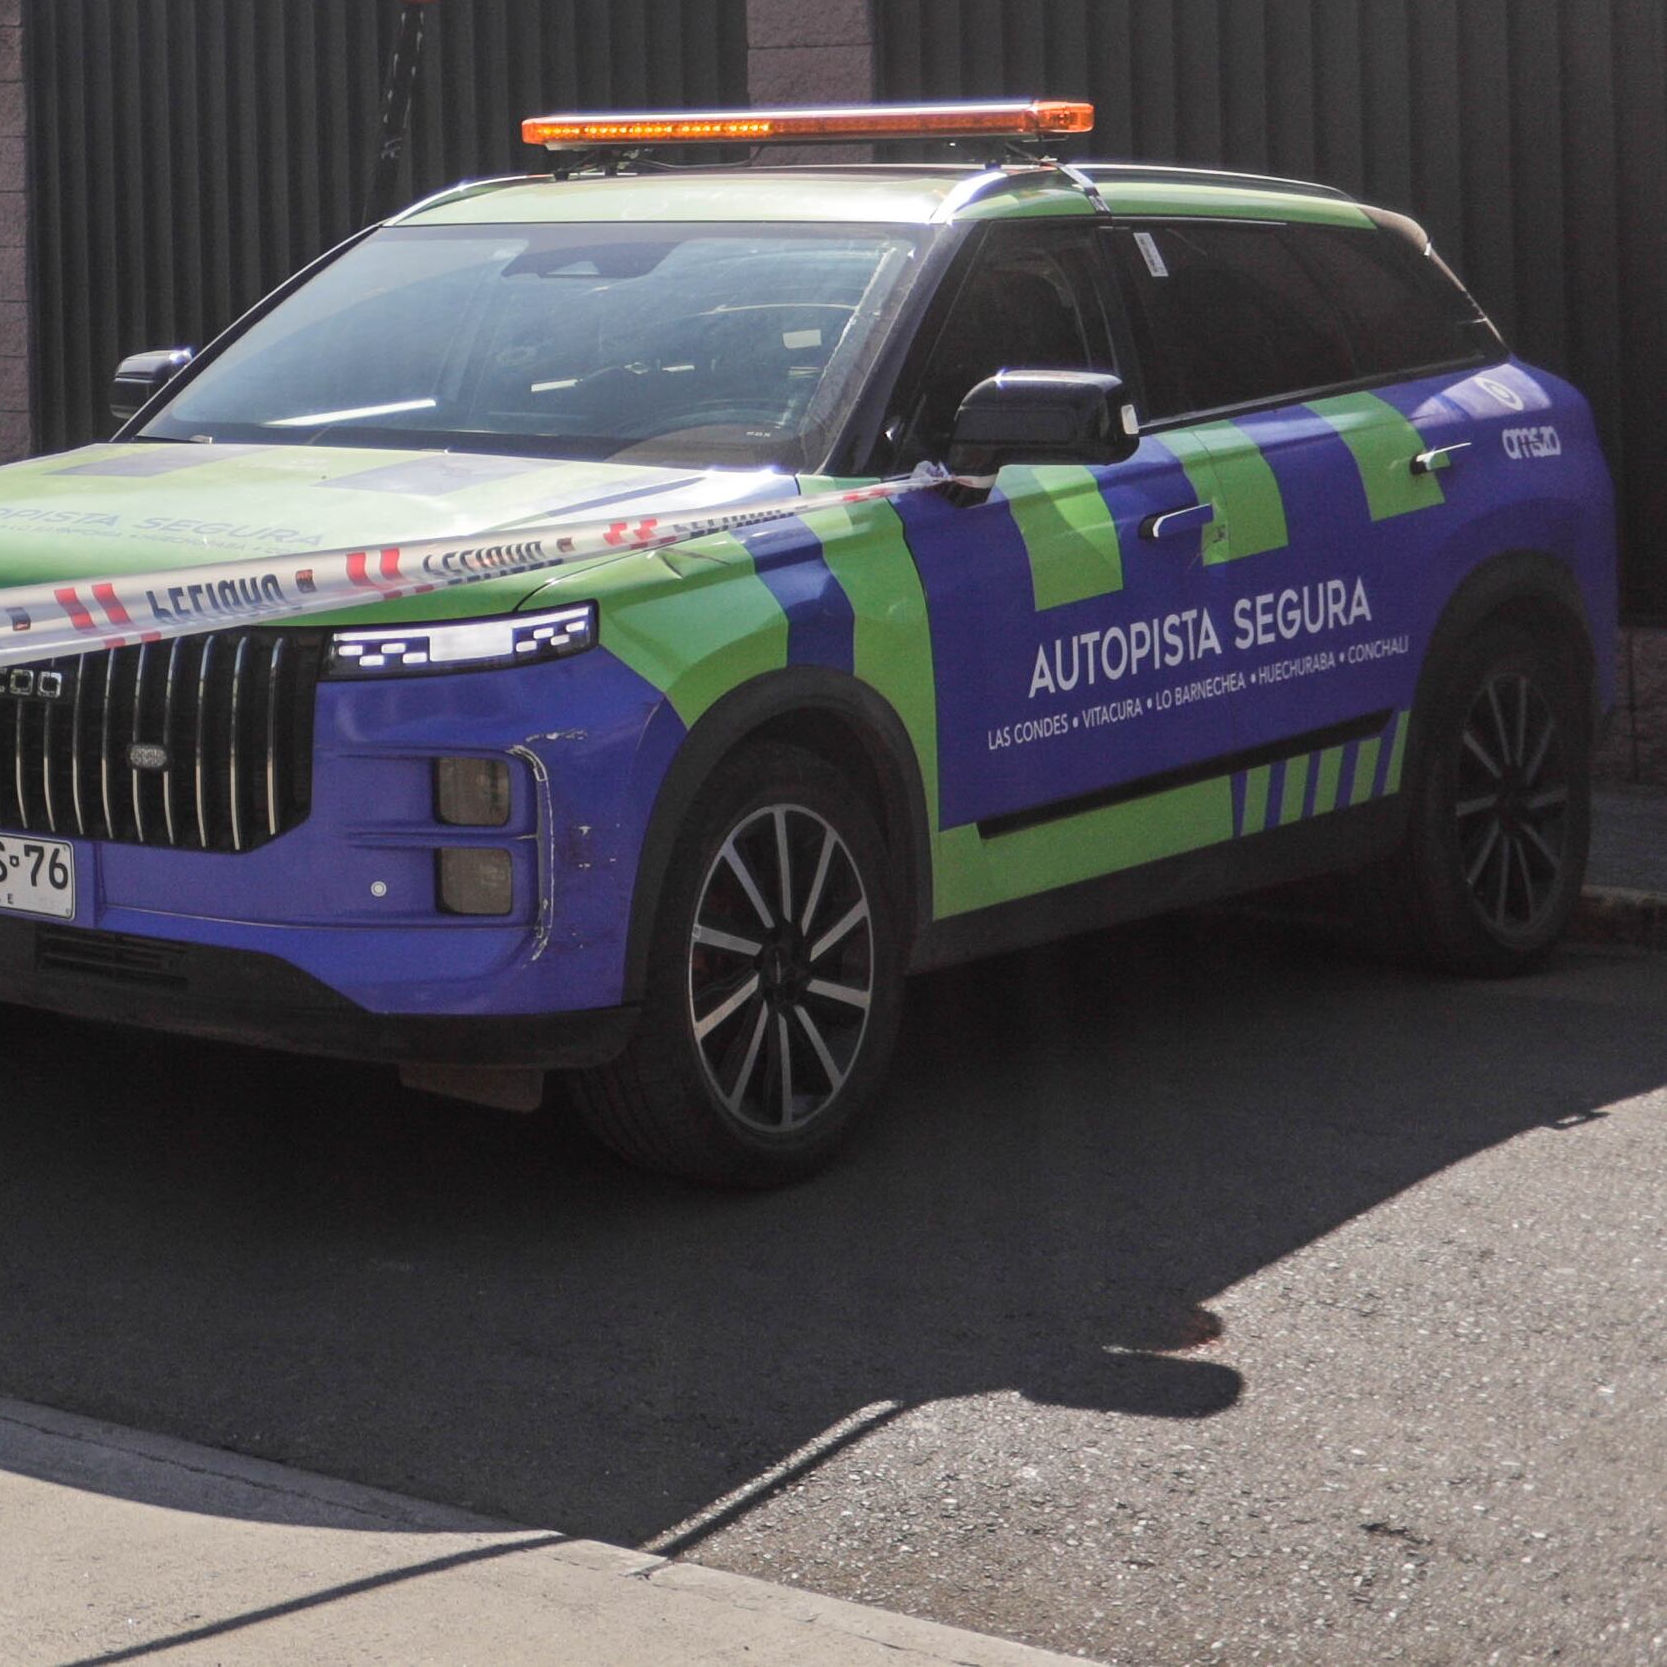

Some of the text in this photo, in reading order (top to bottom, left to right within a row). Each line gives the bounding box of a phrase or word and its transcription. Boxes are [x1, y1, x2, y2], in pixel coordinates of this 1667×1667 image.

[131, 517, 324, 546] SEGURA
[1028, 577, 1372, 698] AUTOPISTA SEGURA
[988, 726, 1011, 750] LAS
[1014, 714, 1068, 744] CONDES
[1082, 698, 1143, 728] VITACURA
[1156, 690, 1172, 711] LO
[1175, 672, 1246, 706] BARNECHEA
[1259, 652, 1336, 685] HUECHURABA
